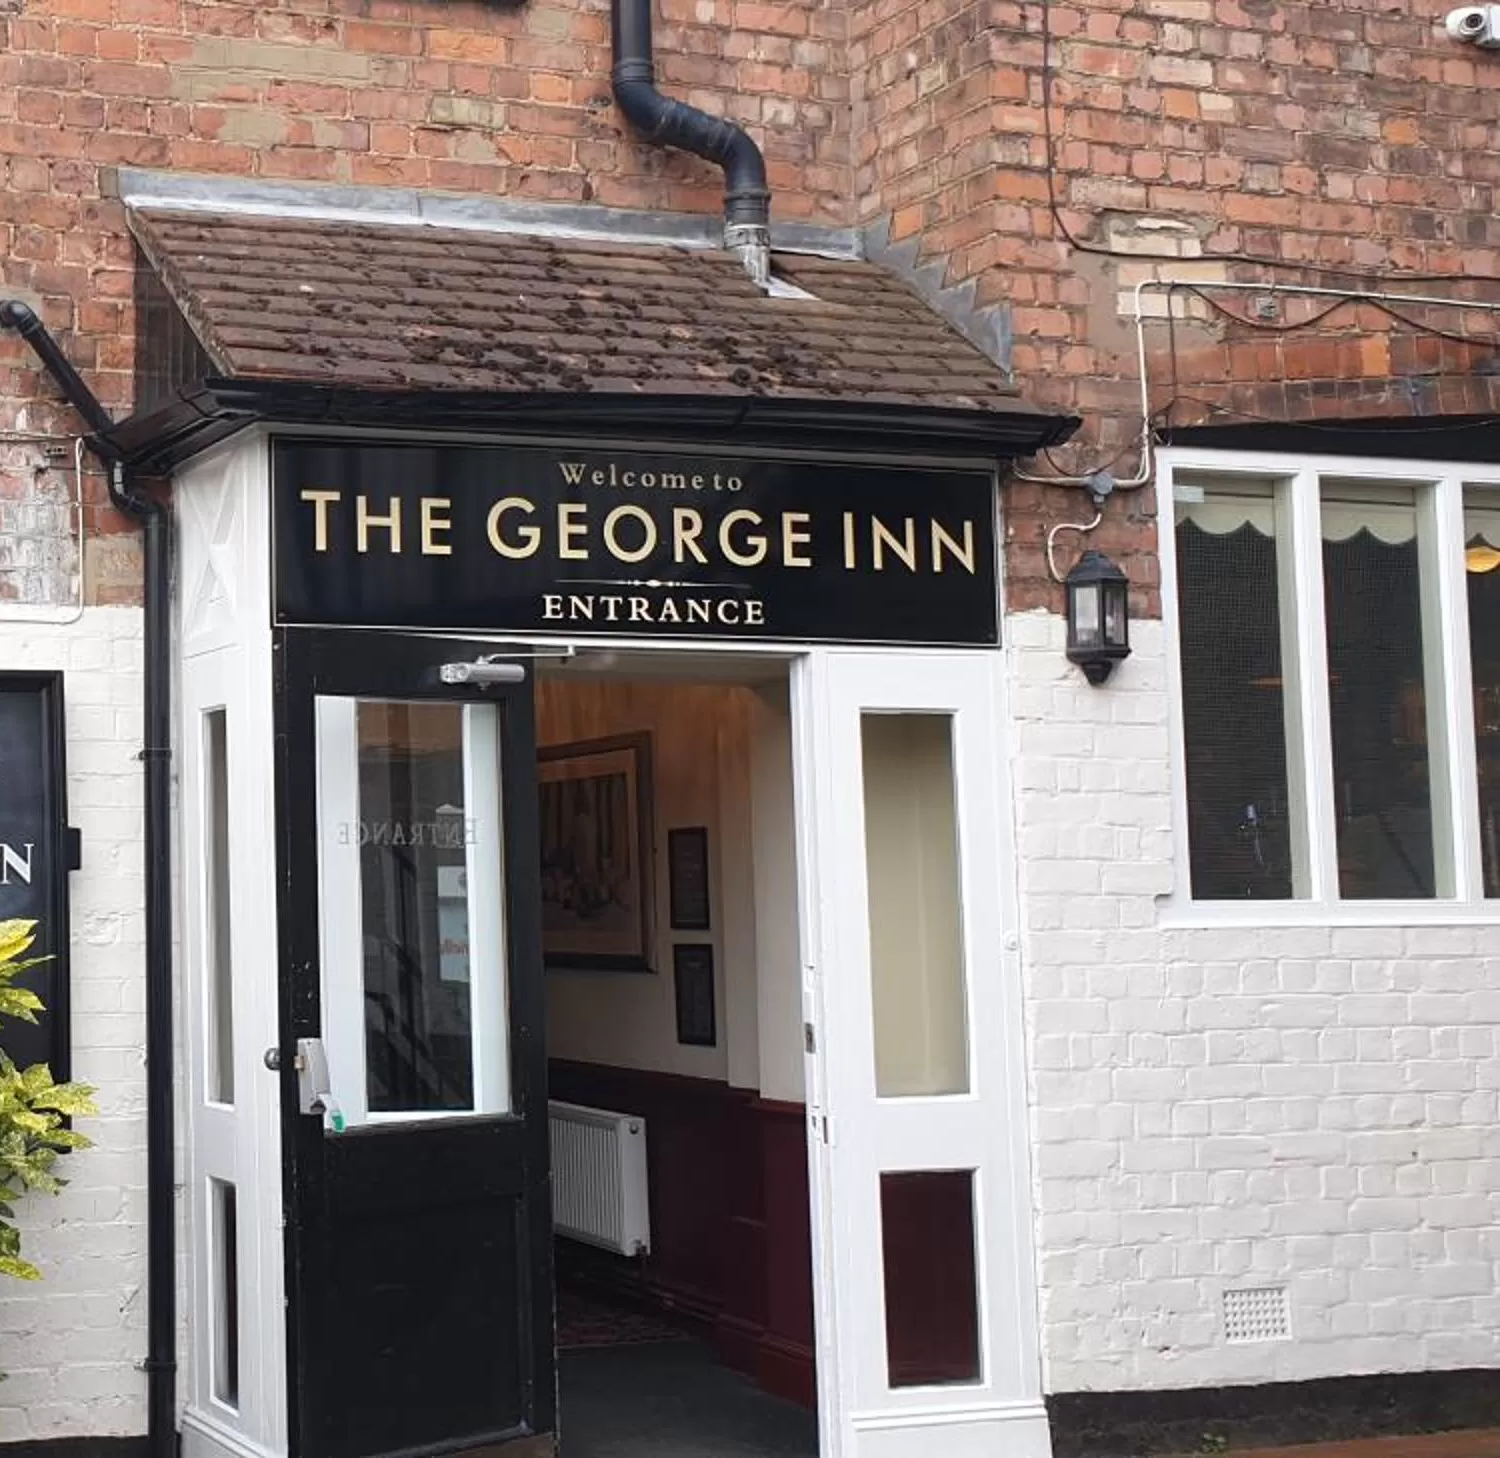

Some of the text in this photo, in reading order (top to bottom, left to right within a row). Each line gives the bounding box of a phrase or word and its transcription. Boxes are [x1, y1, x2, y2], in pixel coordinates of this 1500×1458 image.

[558, 462, 744, 492] Welcome to
[301, 490, 978, 574] THE GEORGE INN
[542, 594, 766, 625] ENTRANCE
